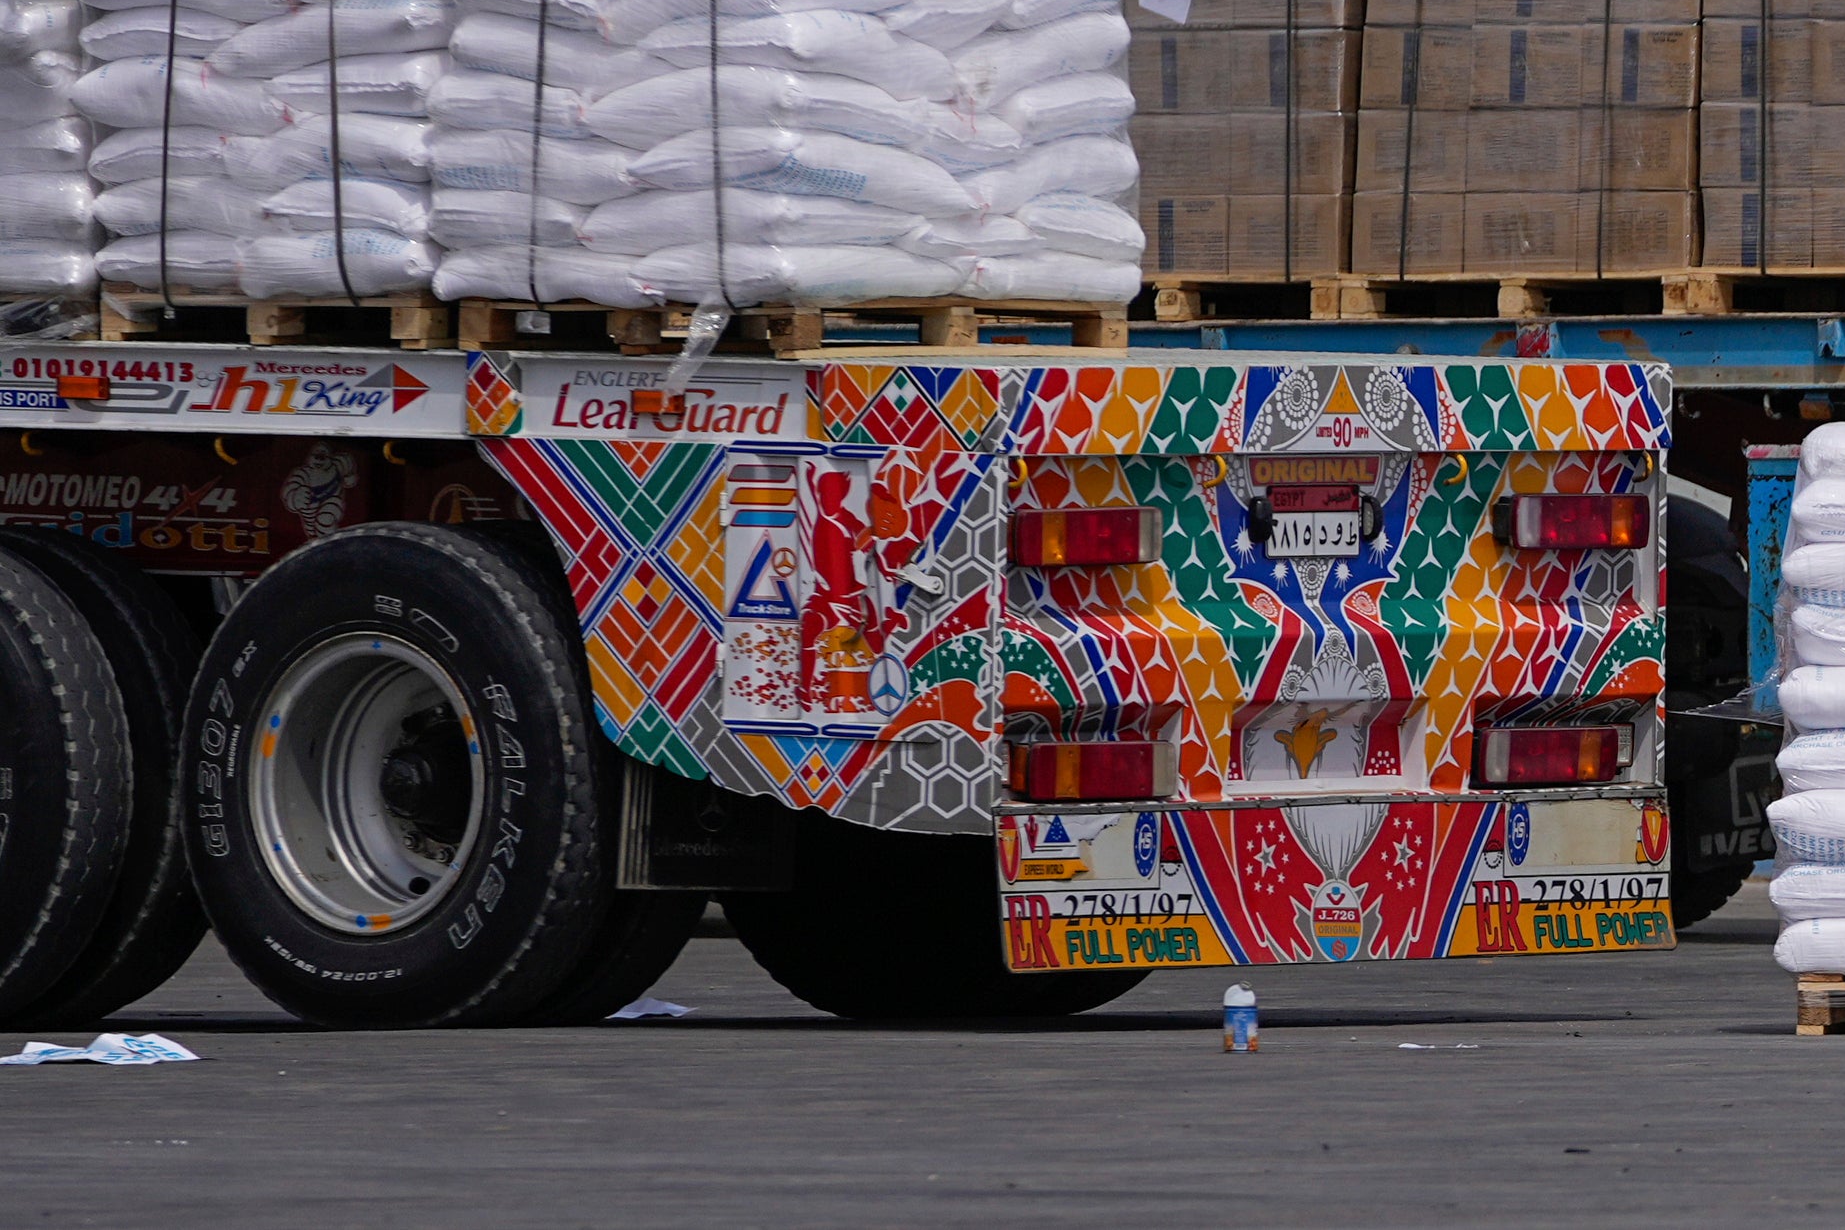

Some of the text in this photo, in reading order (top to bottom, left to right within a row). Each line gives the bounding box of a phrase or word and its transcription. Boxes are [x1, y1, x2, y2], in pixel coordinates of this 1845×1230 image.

[255, 361, 367, 376] Mercedes
[22, 392, 57, 407] PORT
[303, 380, 390, 416] King
[1333, 417, 1352, 448] 90
[1354, 426, 1369, 439] MPH
[1254, 458, 1375, 484] ORIGINAL
[1274, 490, 1305, 507] EGYPT
[1318, 925, 1358, 934] ORIGINAL
[1473, 879, 1528, 952] ER
[1532, 912, 1672, 949] FULL POWER
[1004, 894, 1060, 969] ER
[1065, 927, 1201, 965] FULL POWER
